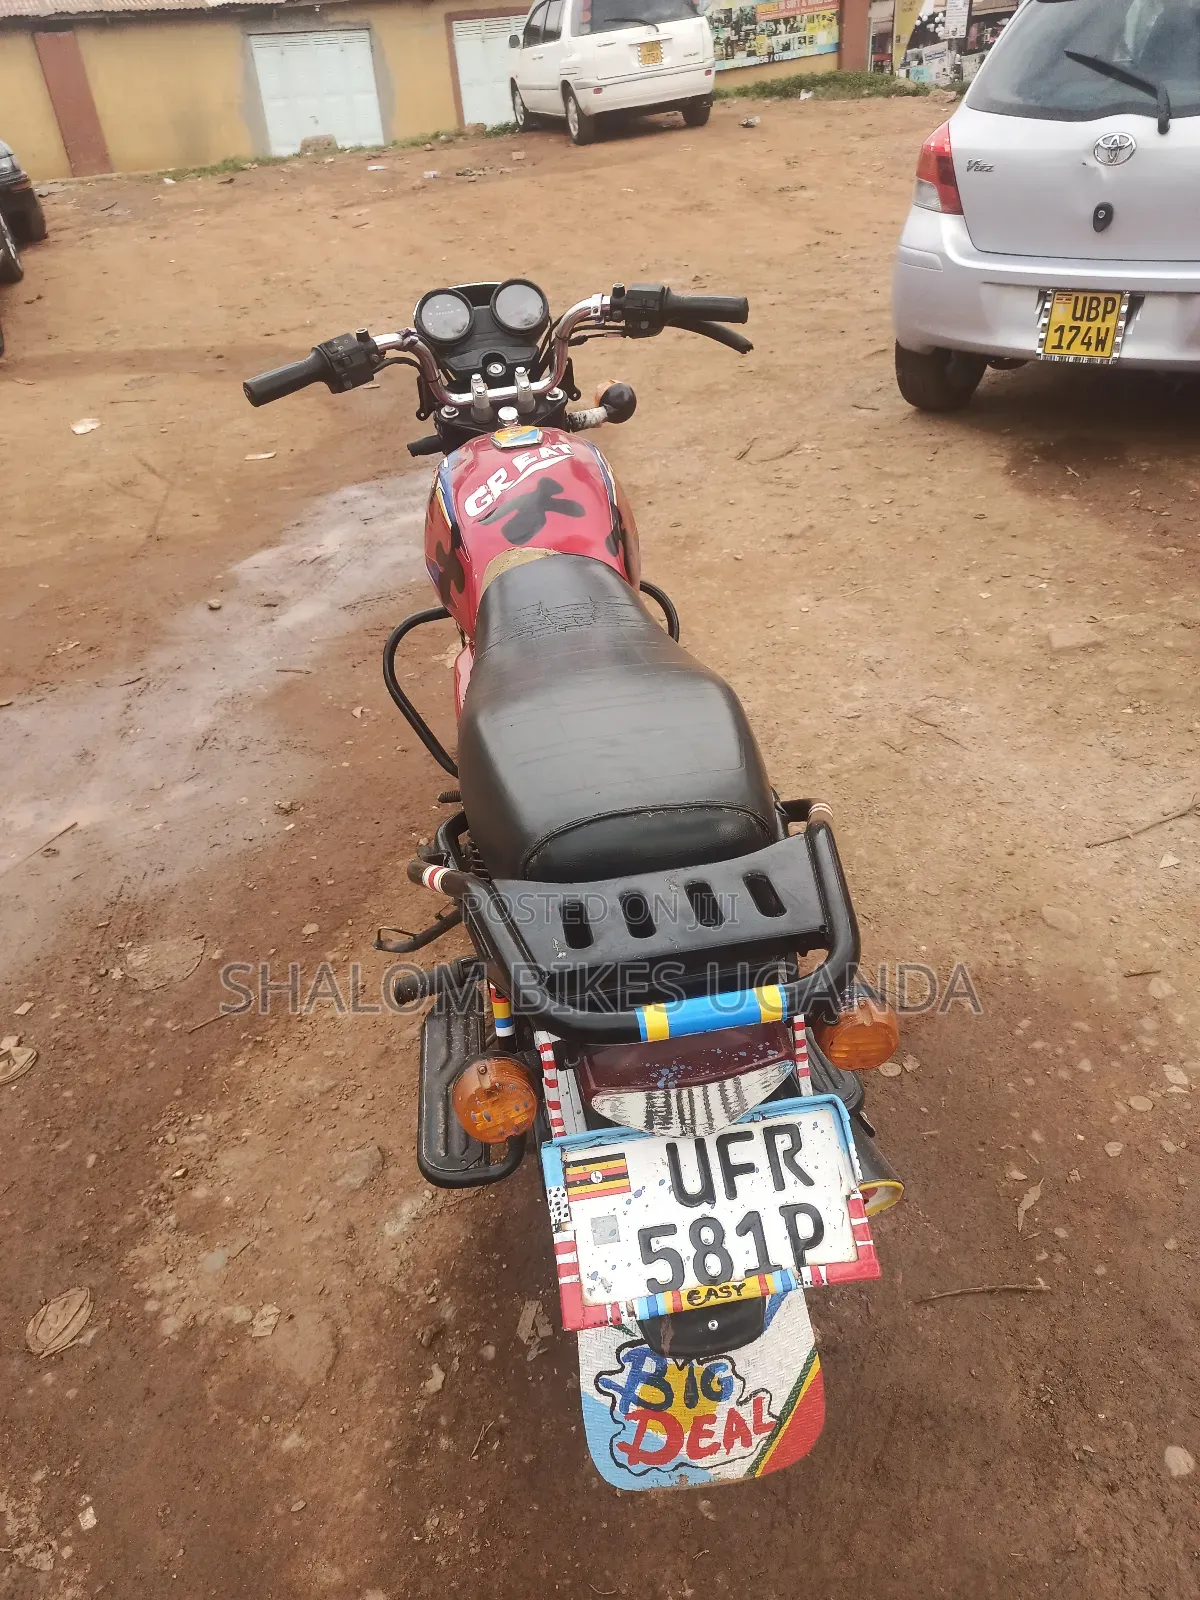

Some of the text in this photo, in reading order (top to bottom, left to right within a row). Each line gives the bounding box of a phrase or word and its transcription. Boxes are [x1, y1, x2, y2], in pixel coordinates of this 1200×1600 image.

[1051, 324, 1111, 353] 174W
[1071, 295, 1117, 324] UBP
[665, 1124, 815, 1208] UFR
[637, 1203, 825, 1294] 581P
[686, 1282, 747, 1307] EASY
[599, 1344, 735, 1415] BIG
[616, 1396, 778, 1467] DEAL
